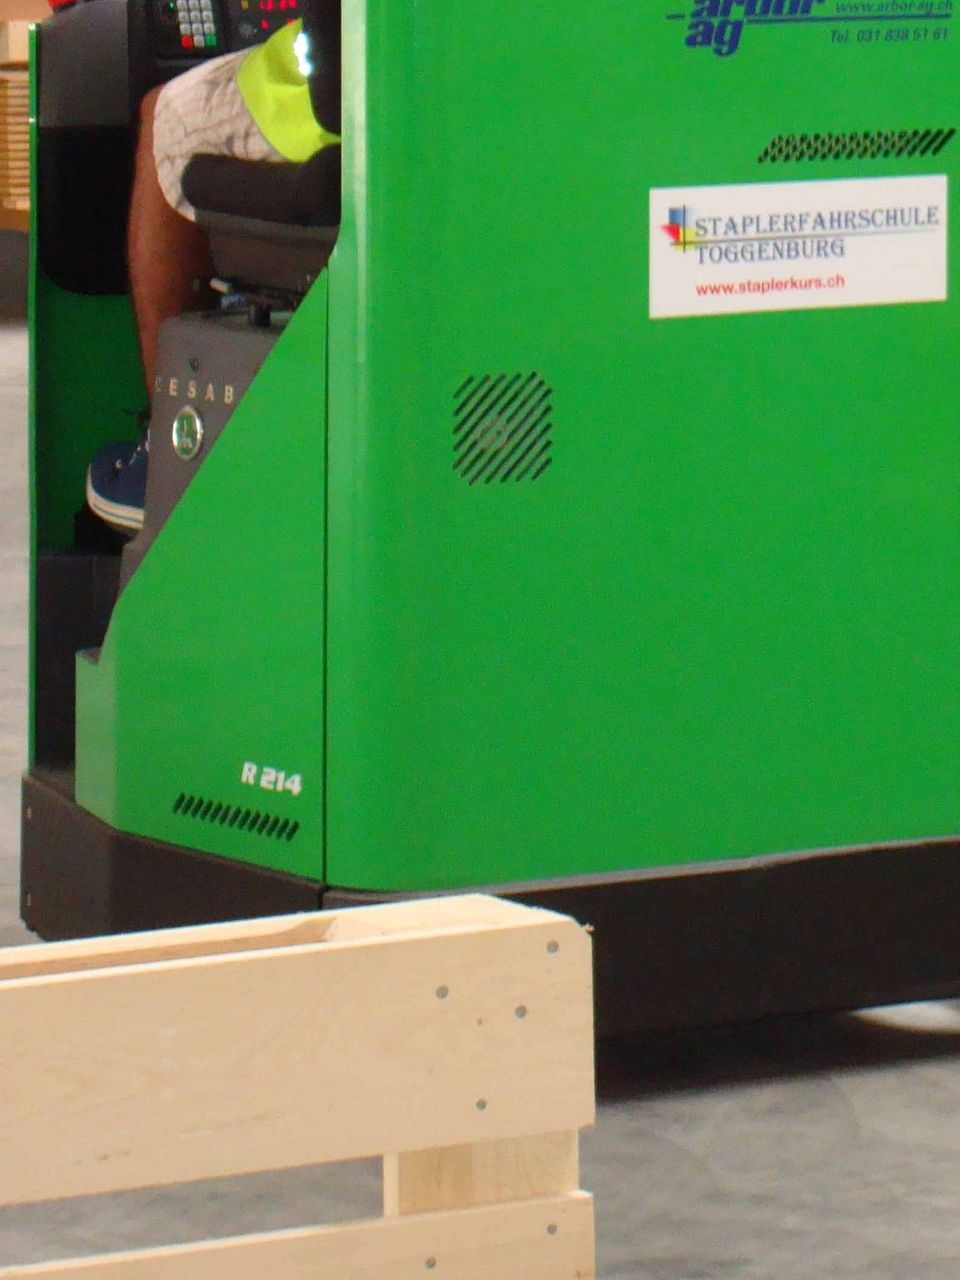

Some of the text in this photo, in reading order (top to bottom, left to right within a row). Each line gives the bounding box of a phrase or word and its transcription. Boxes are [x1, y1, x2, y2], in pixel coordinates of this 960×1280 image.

[684, 18, 743, 58] ag
[695, 206, 940, 238] STAPLERFAHRSCHULE
[697, 238, 846, 265] TOGGENBURG
[696, 273, 845, 297] www.staplerkurs.ch
[241, 762, 302, 796] R 214
